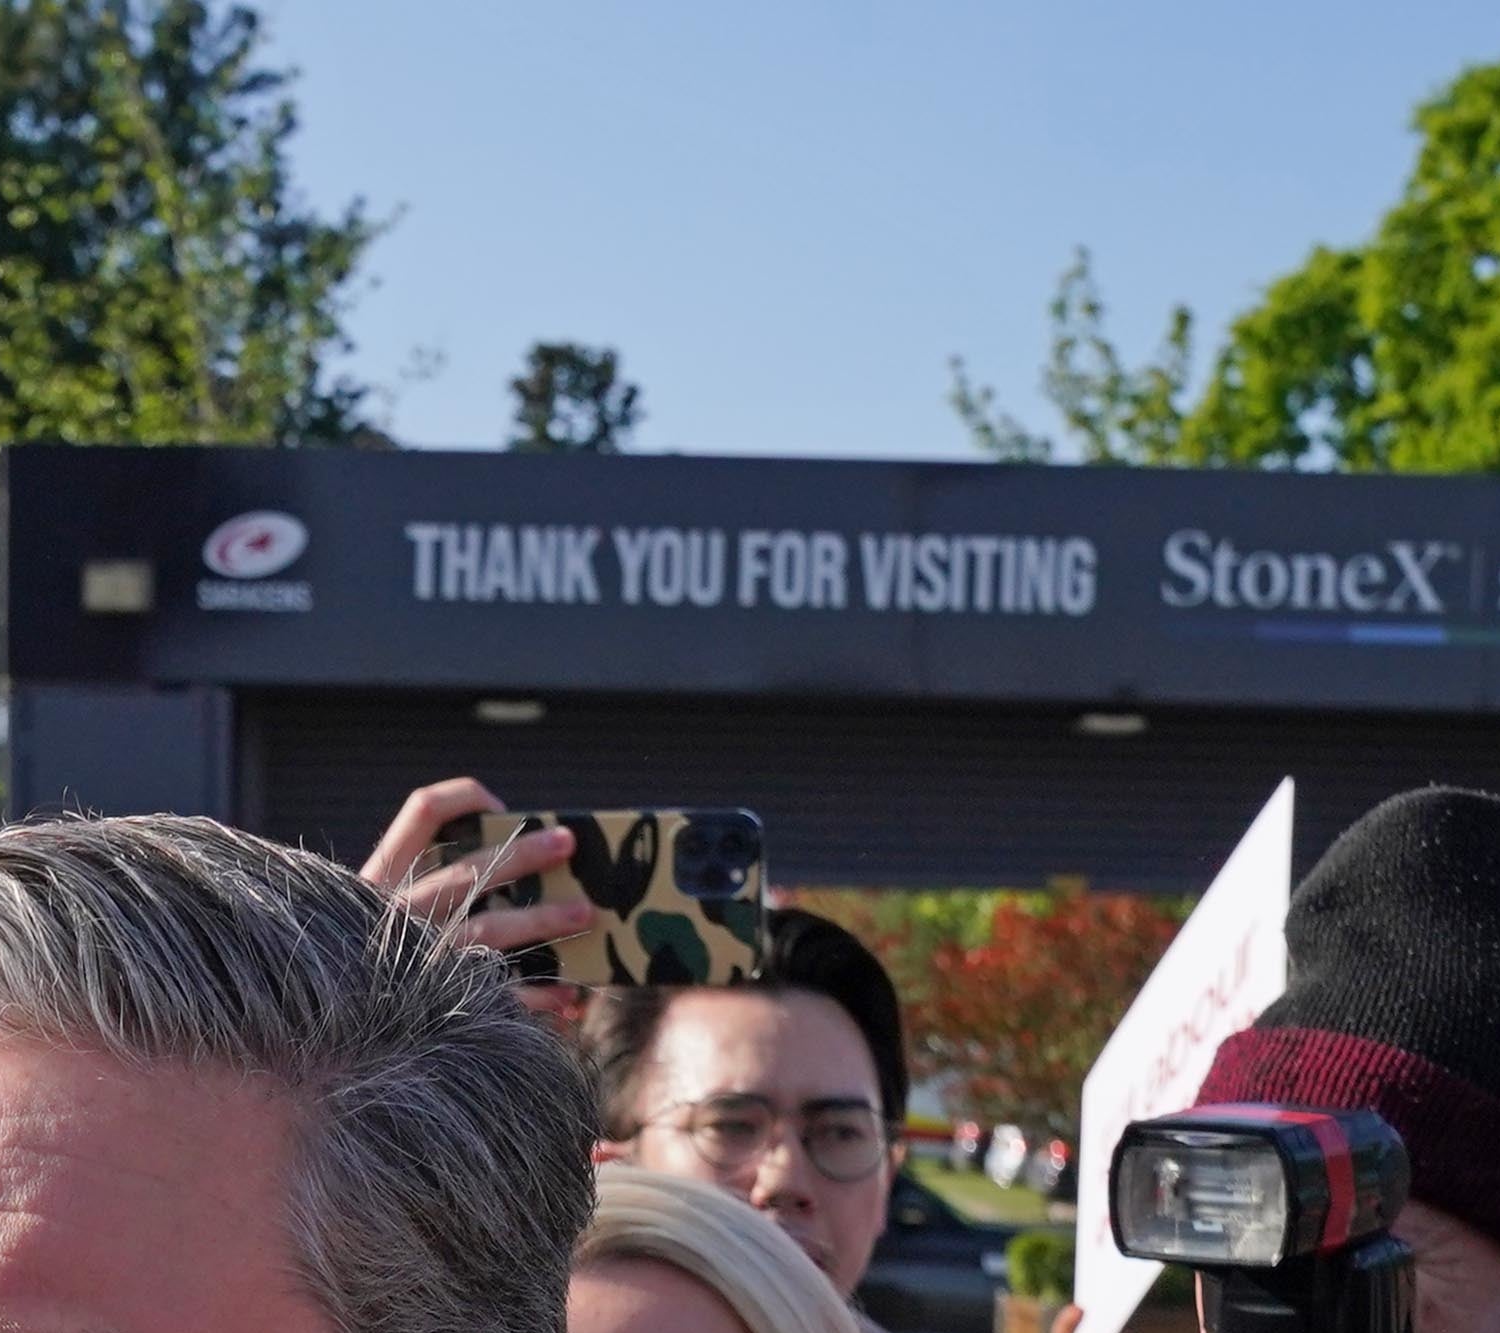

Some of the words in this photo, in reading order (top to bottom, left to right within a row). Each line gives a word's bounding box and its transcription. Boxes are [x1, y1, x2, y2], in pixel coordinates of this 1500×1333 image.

[404, 522, 602, 603] THANK
[612, 526, 726, 607] YOU
[737, 529, 849, 609] FOR
[859, 532, 1097, 616] VISITING
[1160, 528, 1444, 613] StoneX
